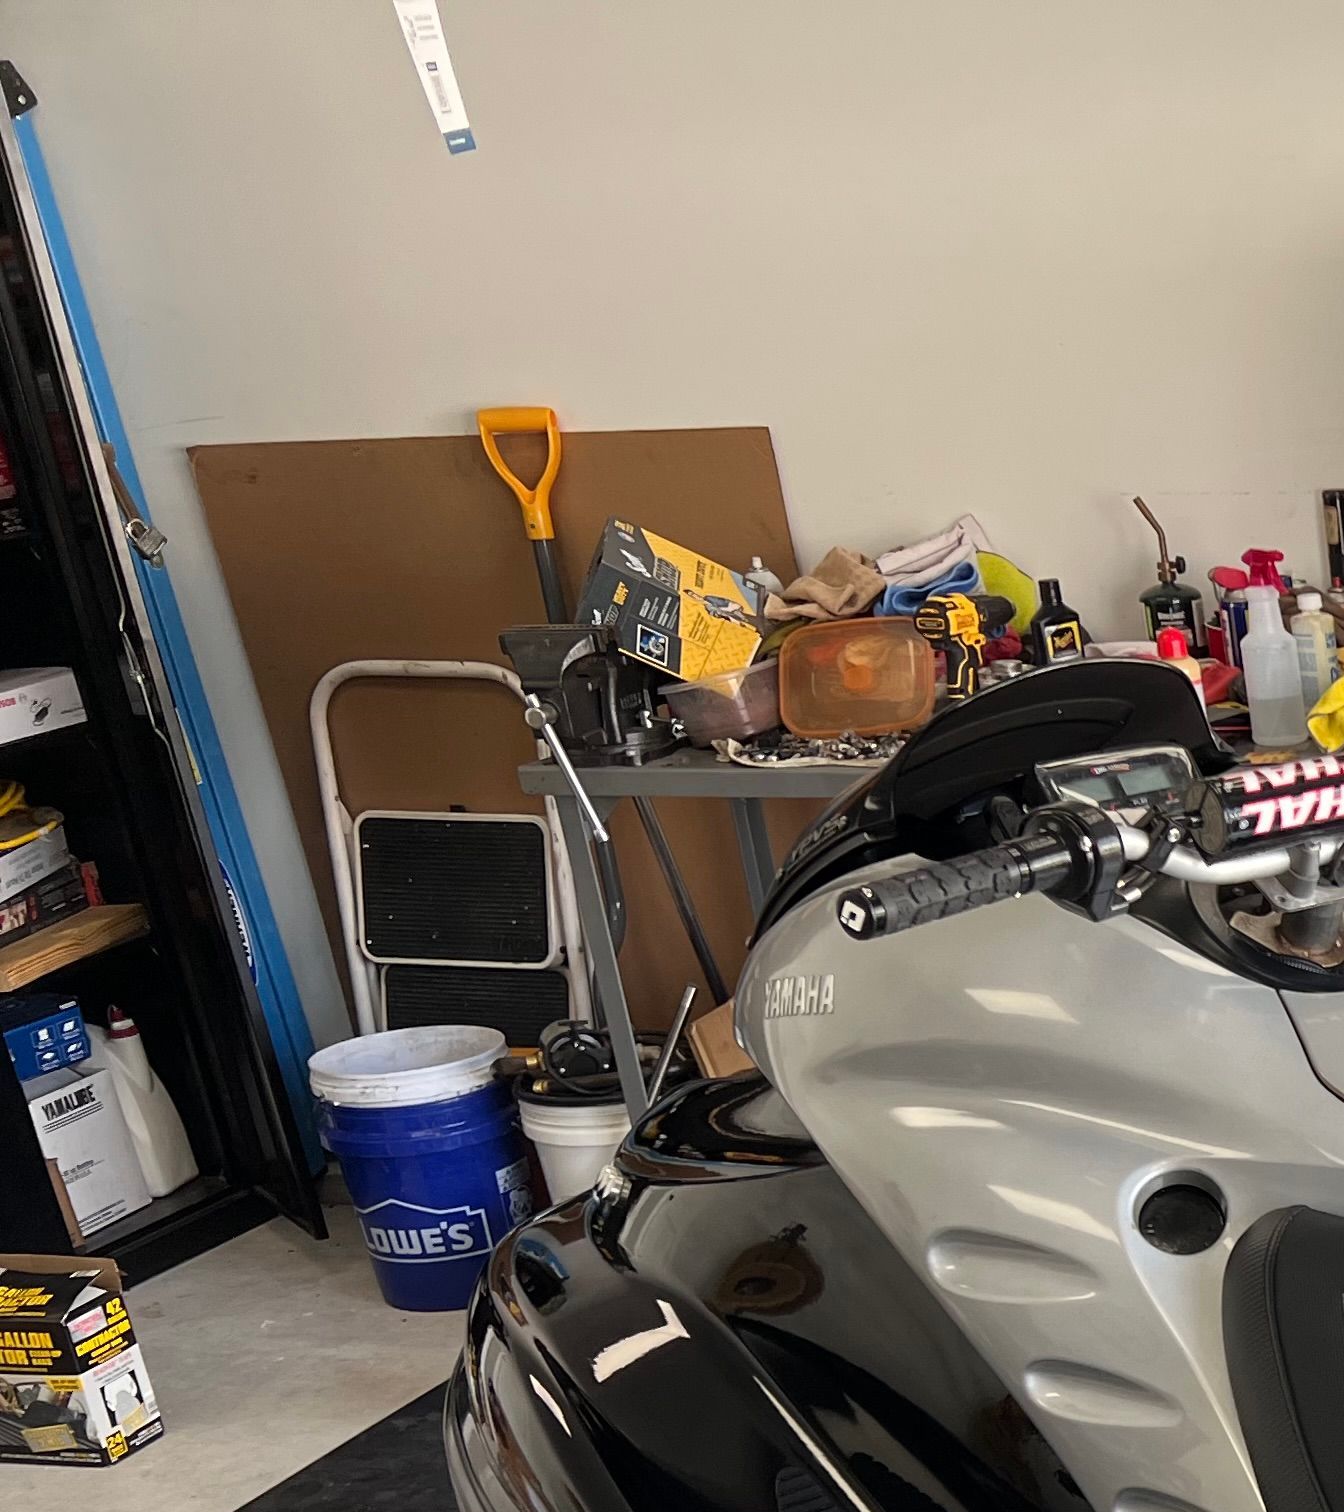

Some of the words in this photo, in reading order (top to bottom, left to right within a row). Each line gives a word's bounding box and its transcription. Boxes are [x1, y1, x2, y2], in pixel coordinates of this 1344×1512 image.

[764, 974, 835, 1018] YAMAHA
[365, 1221, 474, 1255] LOWE'S
[106, 1297, 122, 1316] 42
